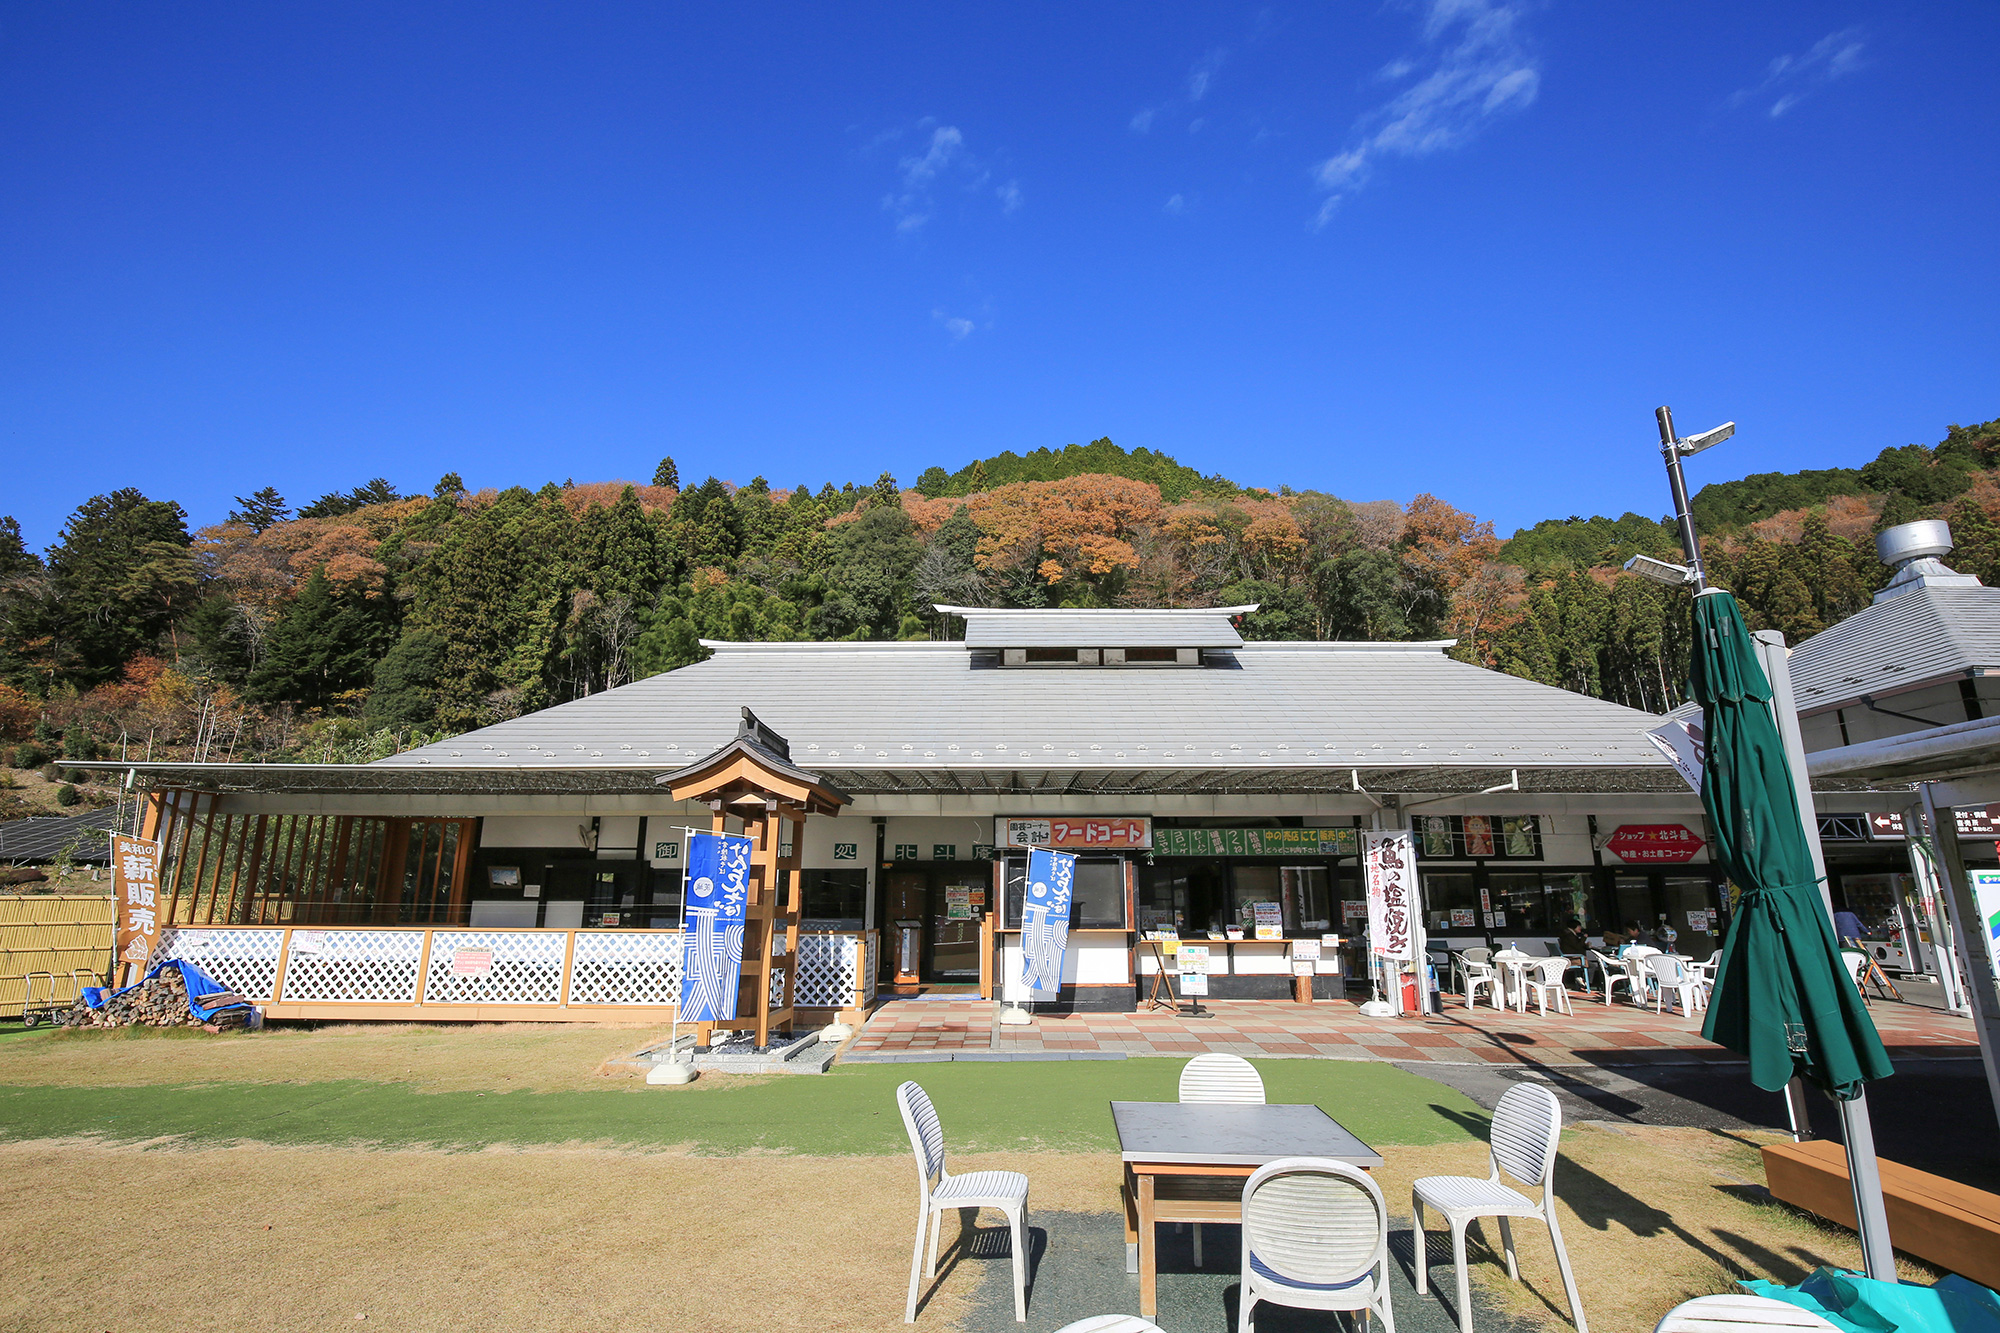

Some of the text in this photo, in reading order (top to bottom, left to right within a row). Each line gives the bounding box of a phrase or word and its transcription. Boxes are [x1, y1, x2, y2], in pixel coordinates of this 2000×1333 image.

[1010, 823, 1049, 831] 園芸コーナー
[1054, 823, 1141, 843] フードコート
[1016, 831, 1041, 843] 会計
[1174, 831, 1188, 854] コロッケ
[1229, 830, 1243, 854] つくね
[1620, 830, 1689, 840] ショップ 北斗星
[120, 841, 156, 856] 美和の
[896, 845, 994, 860] 北斗庵
[1621, 850, 1692, 858] 物産・お土産コーナー
[1370, 840, 1381, 898] ご当地名物
[123, 855, 156, 936] 薪販売
